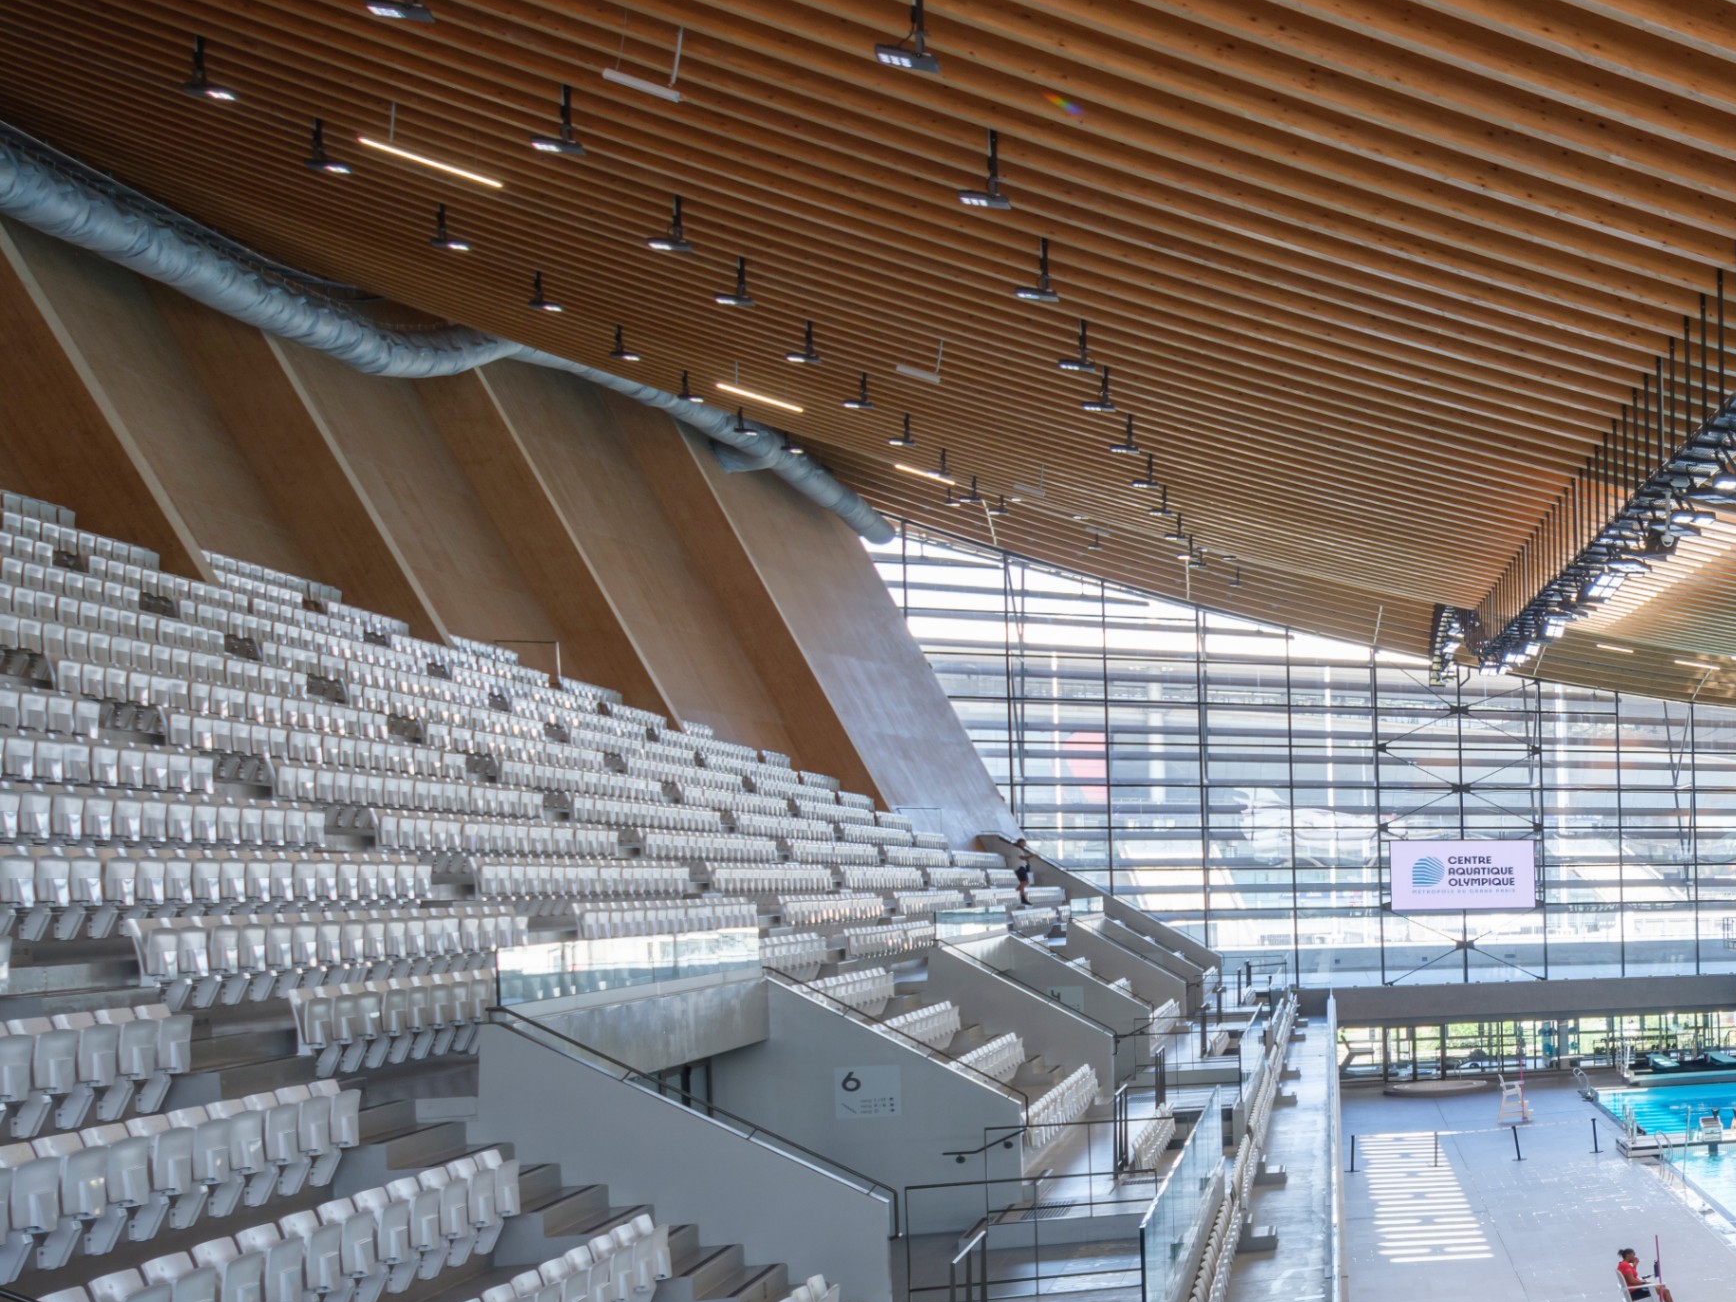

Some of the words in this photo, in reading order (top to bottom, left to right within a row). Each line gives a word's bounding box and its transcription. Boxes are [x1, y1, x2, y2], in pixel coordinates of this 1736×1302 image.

[1448, 856, 1492, 865] CENTRE
[1448, 866, 1514, 876] AQUATIQUE
[1448, 877, 1516, 887] OLYMPIQUE
[841, 1071, 861, 1092] 6
